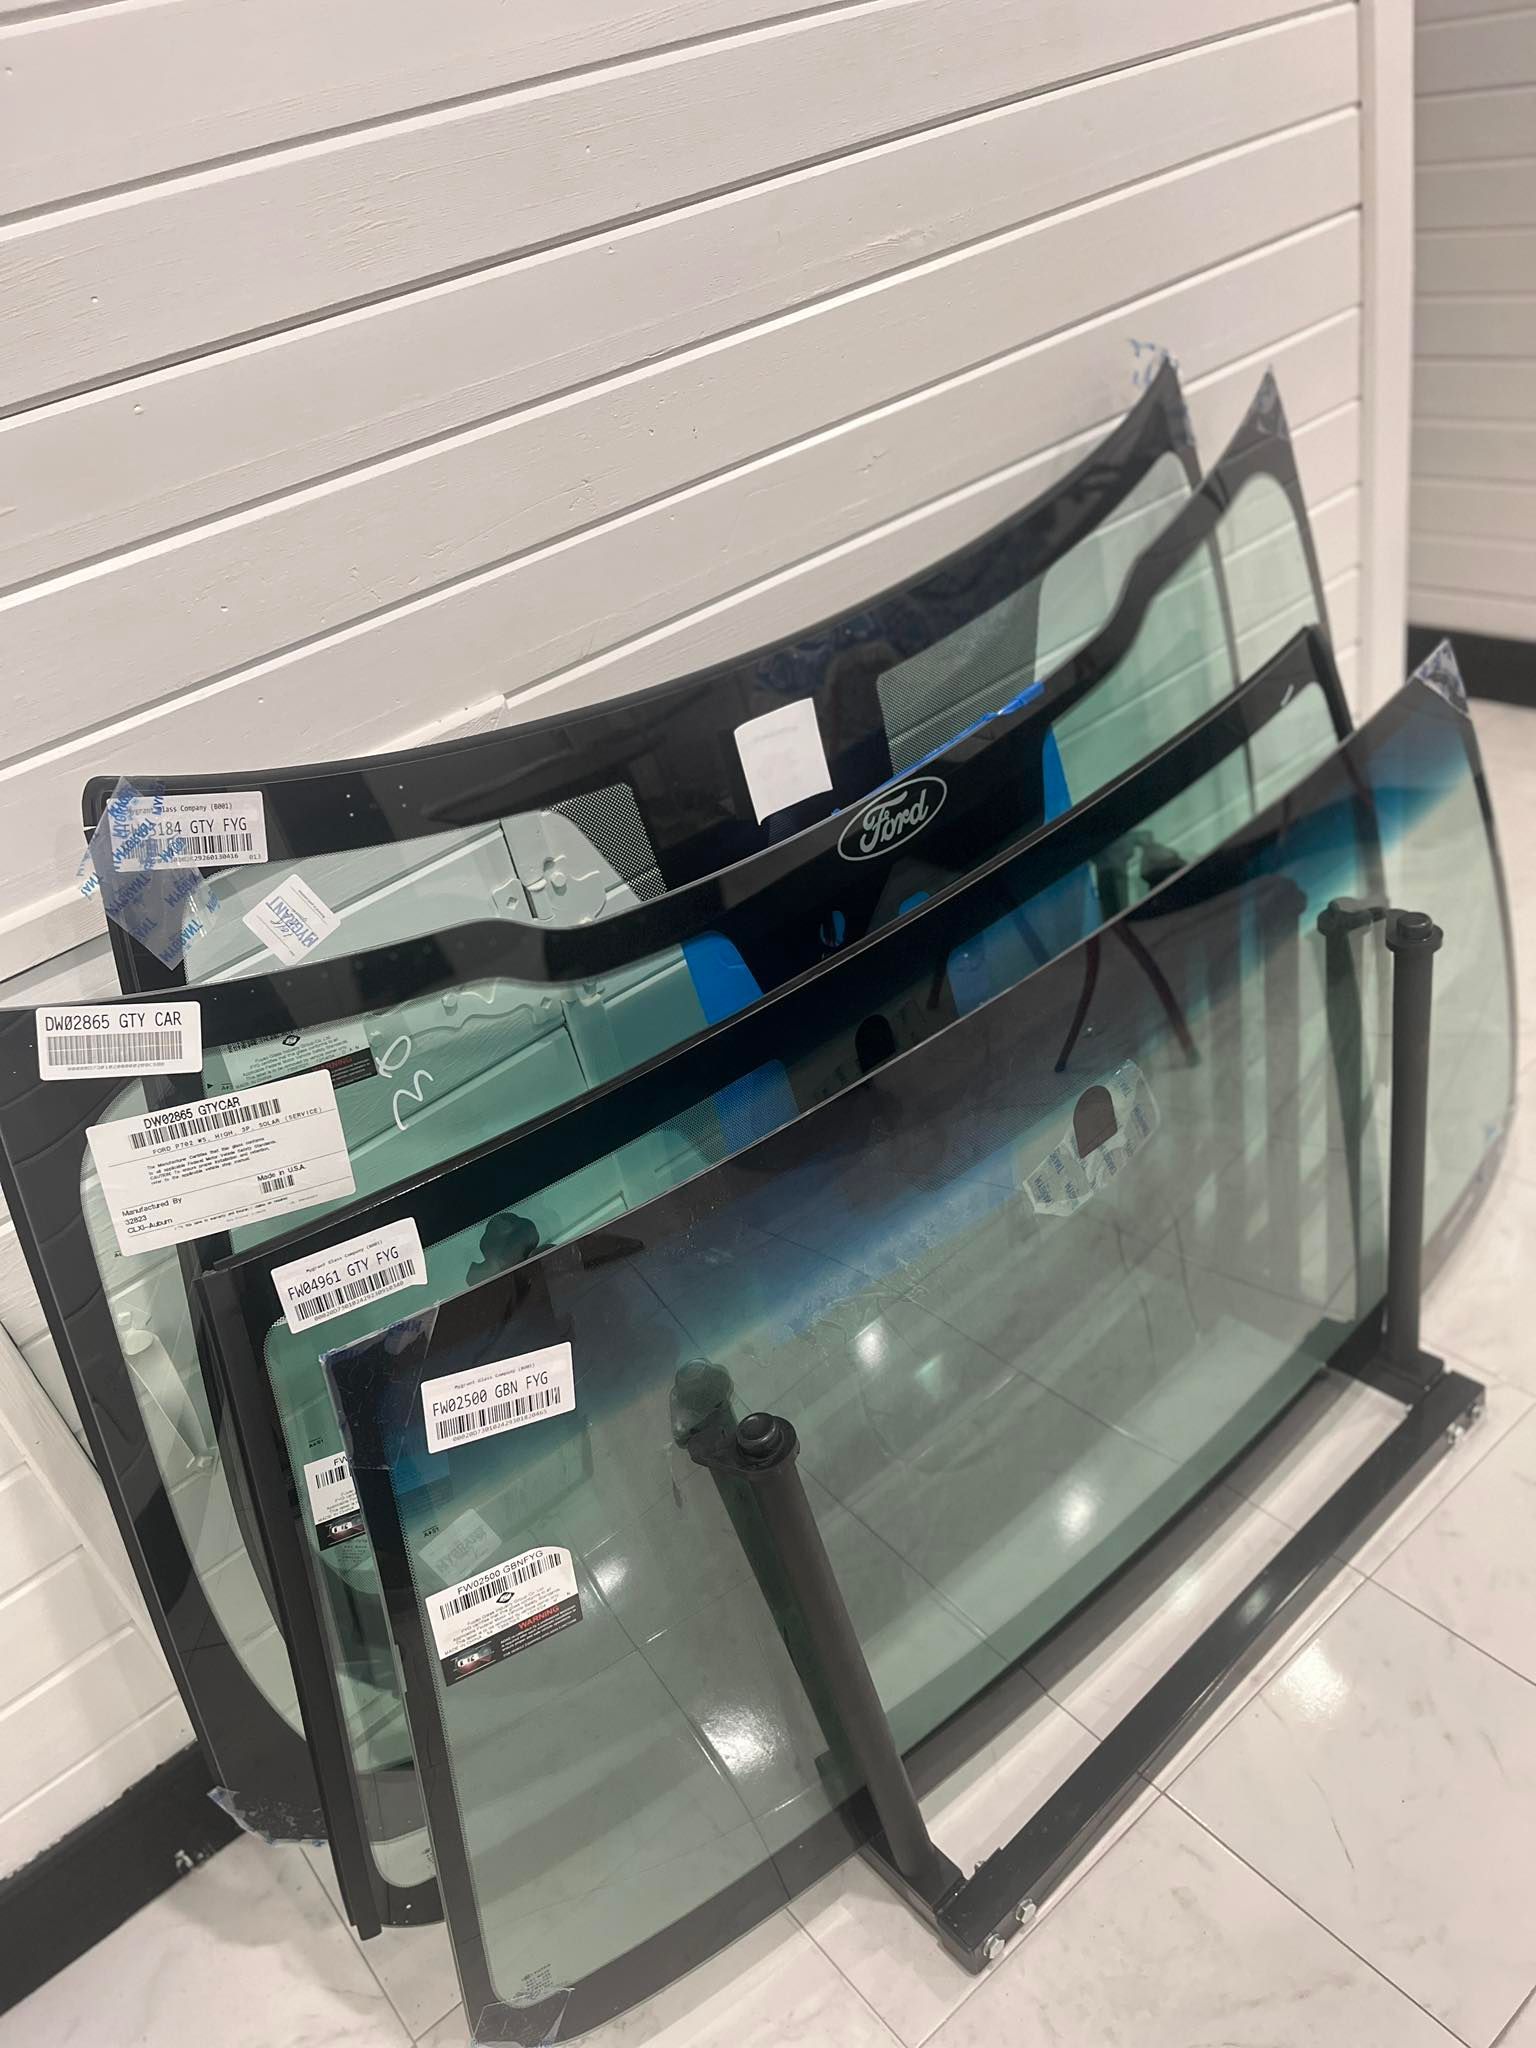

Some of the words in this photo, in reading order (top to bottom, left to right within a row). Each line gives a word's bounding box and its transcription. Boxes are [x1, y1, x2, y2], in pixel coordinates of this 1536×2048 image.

[180, 804, 207, 814] Company
[190, 819, 215, 834] GTY
[223, 817, 247, 832] FYG
[860, 789, 929, 853] Ford
[45, 1014, 110, 1032] DW02865
[119, 1012, 146, 1029] GTY
[155, 1011, 182, 1027] CAR
[143, 1109, 193, 1130] DW02865
[198, 1096, 241, 1116] GTYCAR
[258, 1118, 280, 1128] SOLAR
[284, 1107, 323, 1123] (SERVICE)
[256, 1171, 275, 1181] Made
[121, 1200, 169, 1217] Manufactured
[172, 1196, 182, 1205] By
[287, 1270, 342, 1301] FW04961
[346, 1257, 369, 1277] GTY
[376, 1246, 399, 1265] FYG
[433, 1389, 488, 1417] FW02500
[495, 1380, 518, 1398] GBN
[526, 1371, 548, 1390] FYG
[457, 1570, 501, 1595] FW02500
[502, 1550, 544, 1574] GBNFYG
[518, 1605, 561, 1630] WARNING
